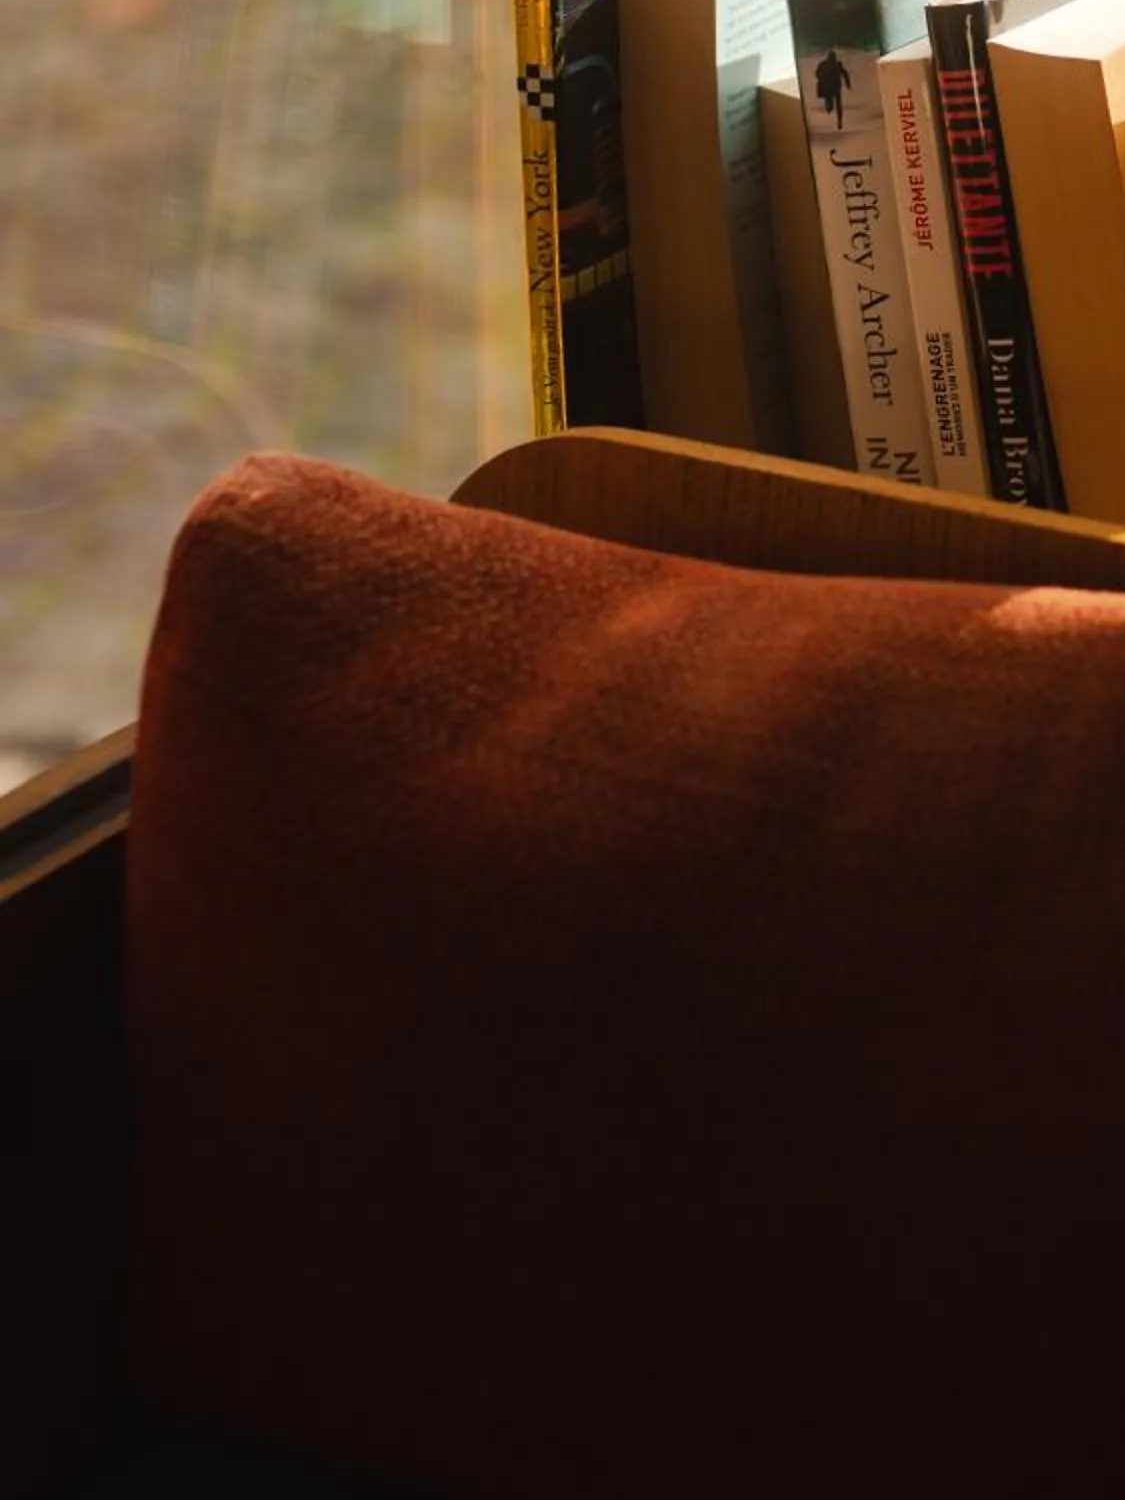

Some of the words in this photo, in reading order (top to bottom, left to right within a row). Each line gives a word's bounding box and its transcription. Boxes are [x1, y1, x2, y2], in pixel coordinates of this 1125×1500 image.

[898, 88, 922, 170] KERVIEL
[523, 149, 551, 219] York
[909, 175, 933, 250] JÉRÔME
[938, 68, 1014, 278] DILETTANTE
[529, 227, 555, 295] New
[830, 148, 880, 271] Jeffrey
[857, 284, 897, 405] Archer
[926, 332, 956, 457] L'ENGRENAGE
[988, 338, 1017, 426] Dana
